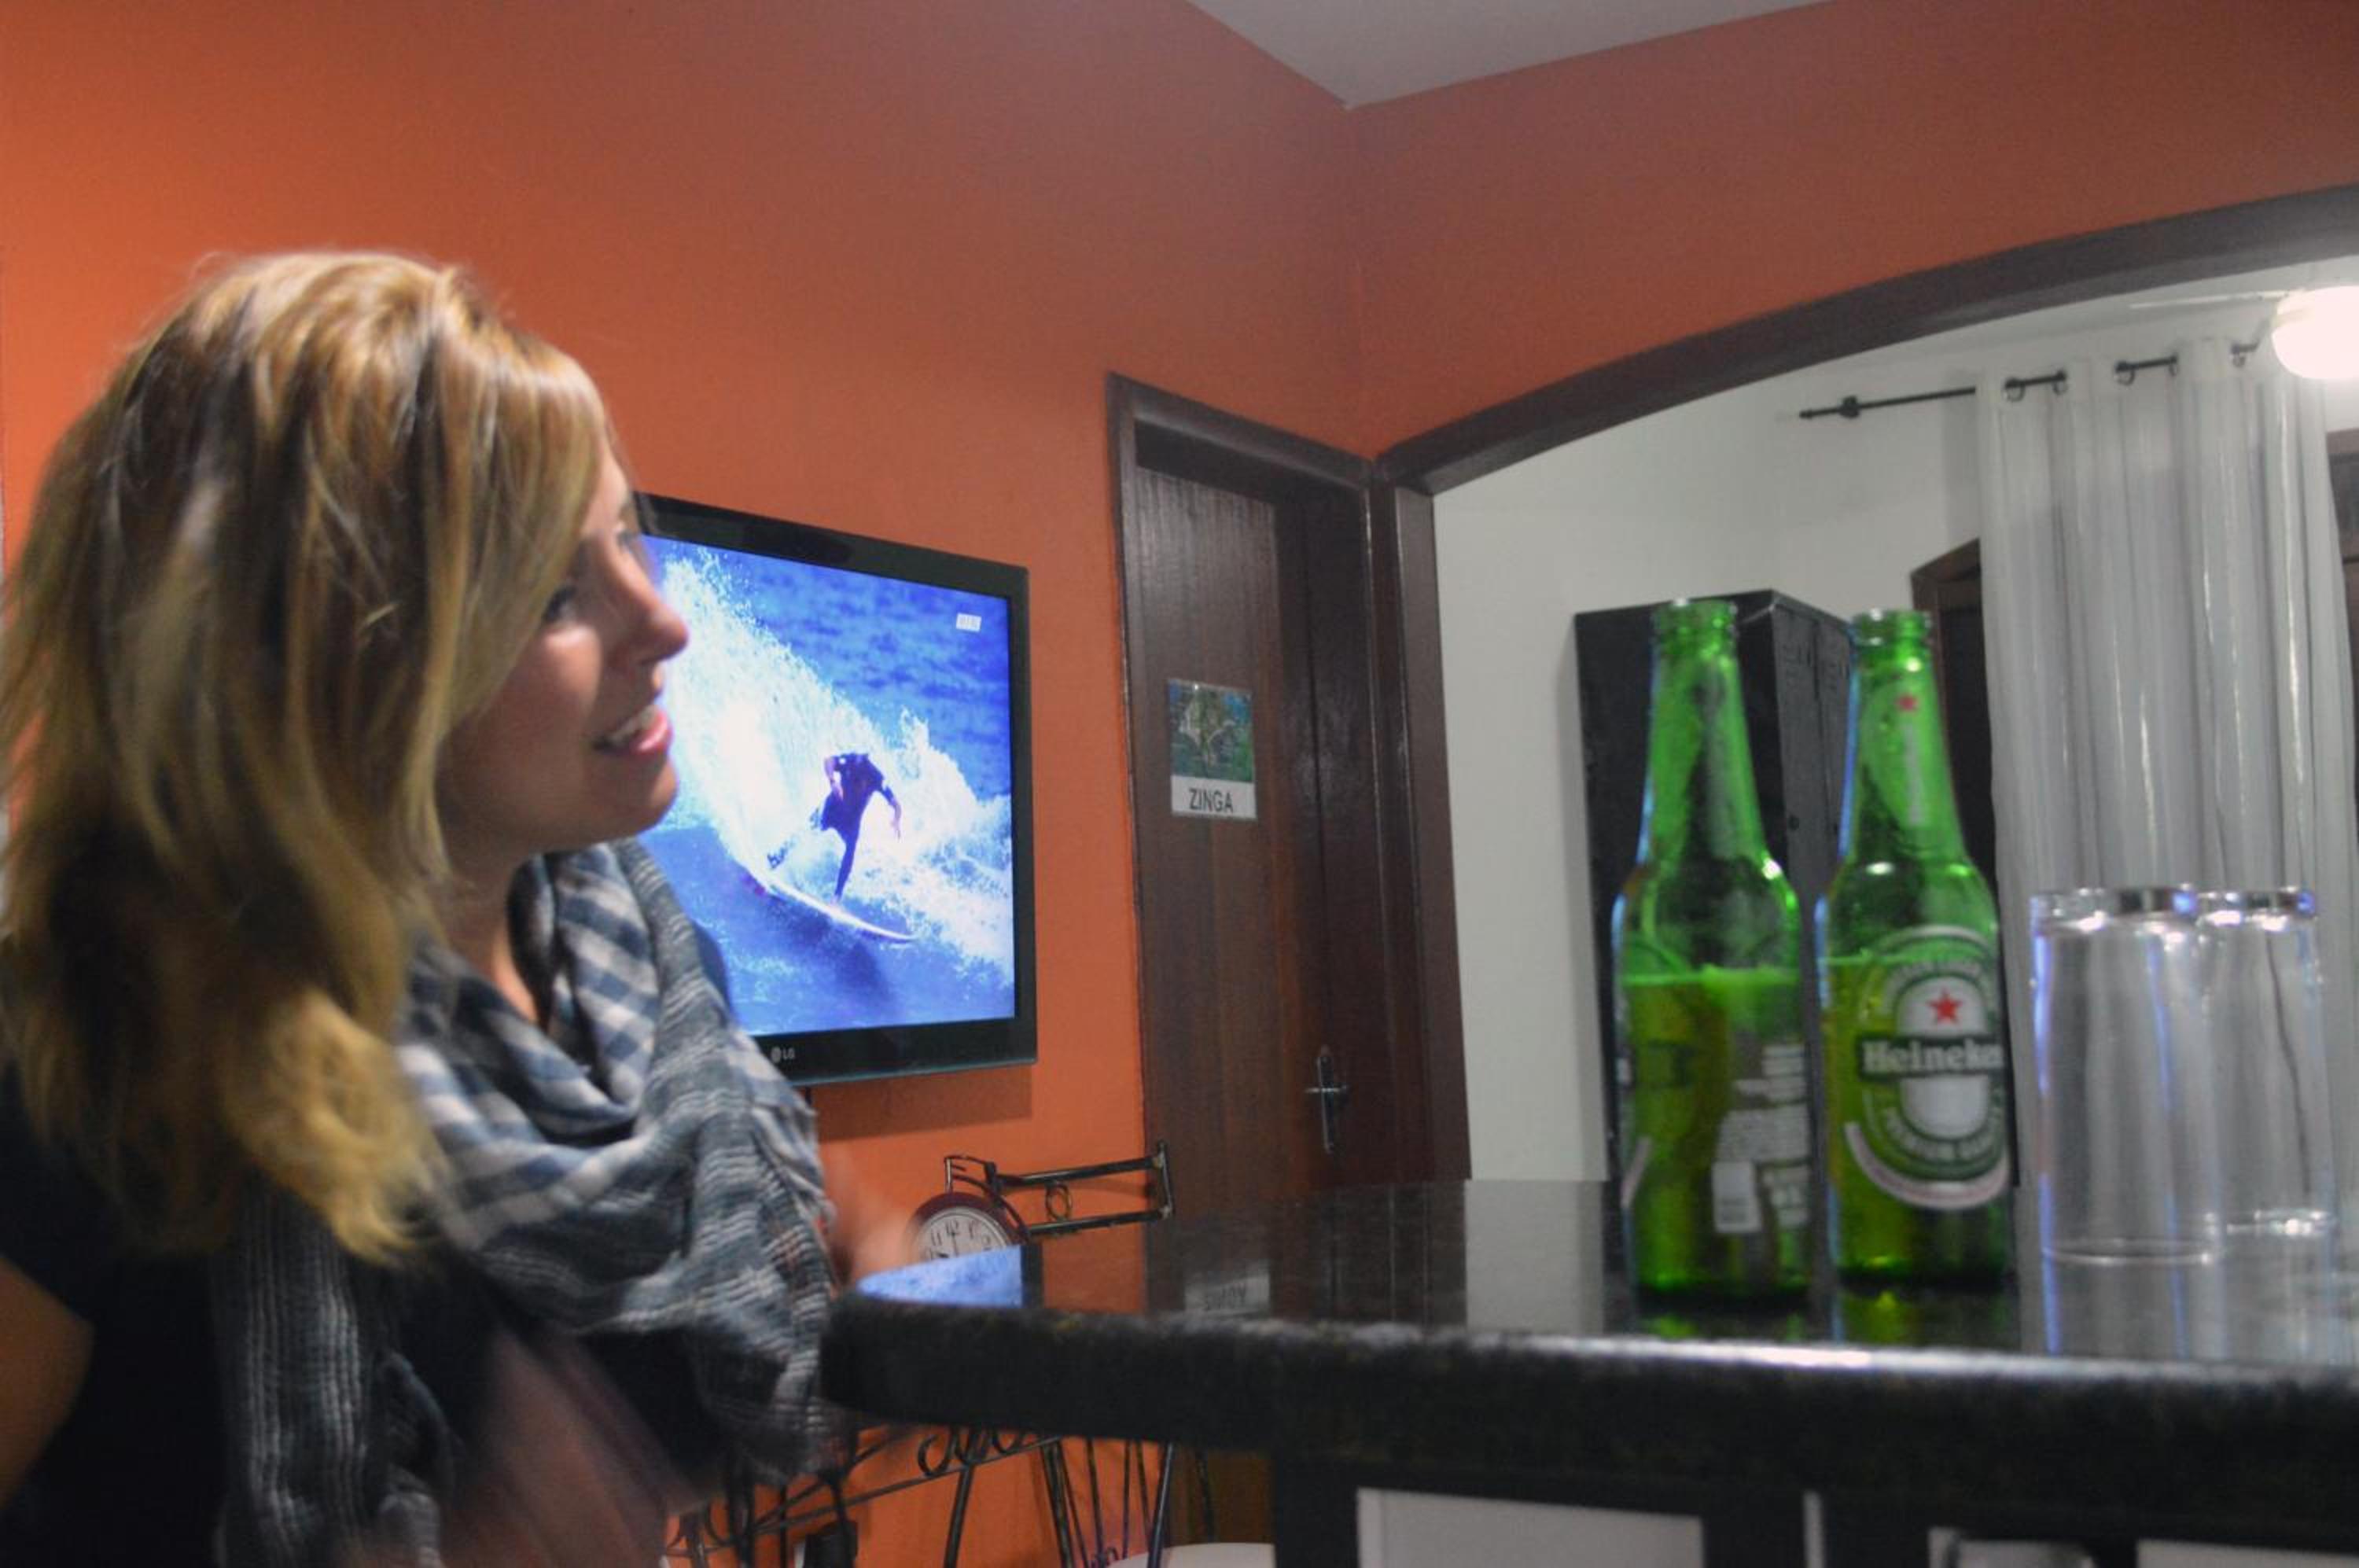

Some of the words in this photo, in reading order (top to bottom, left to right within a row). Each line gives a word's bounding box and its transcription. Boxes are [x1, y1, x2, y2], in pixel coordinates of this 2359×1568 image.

[1189, 788, 1234, 813] ZINGA
[783, 1046, 796, 1060] LG
[1863, 1040, 2004, 1074] Heineke
